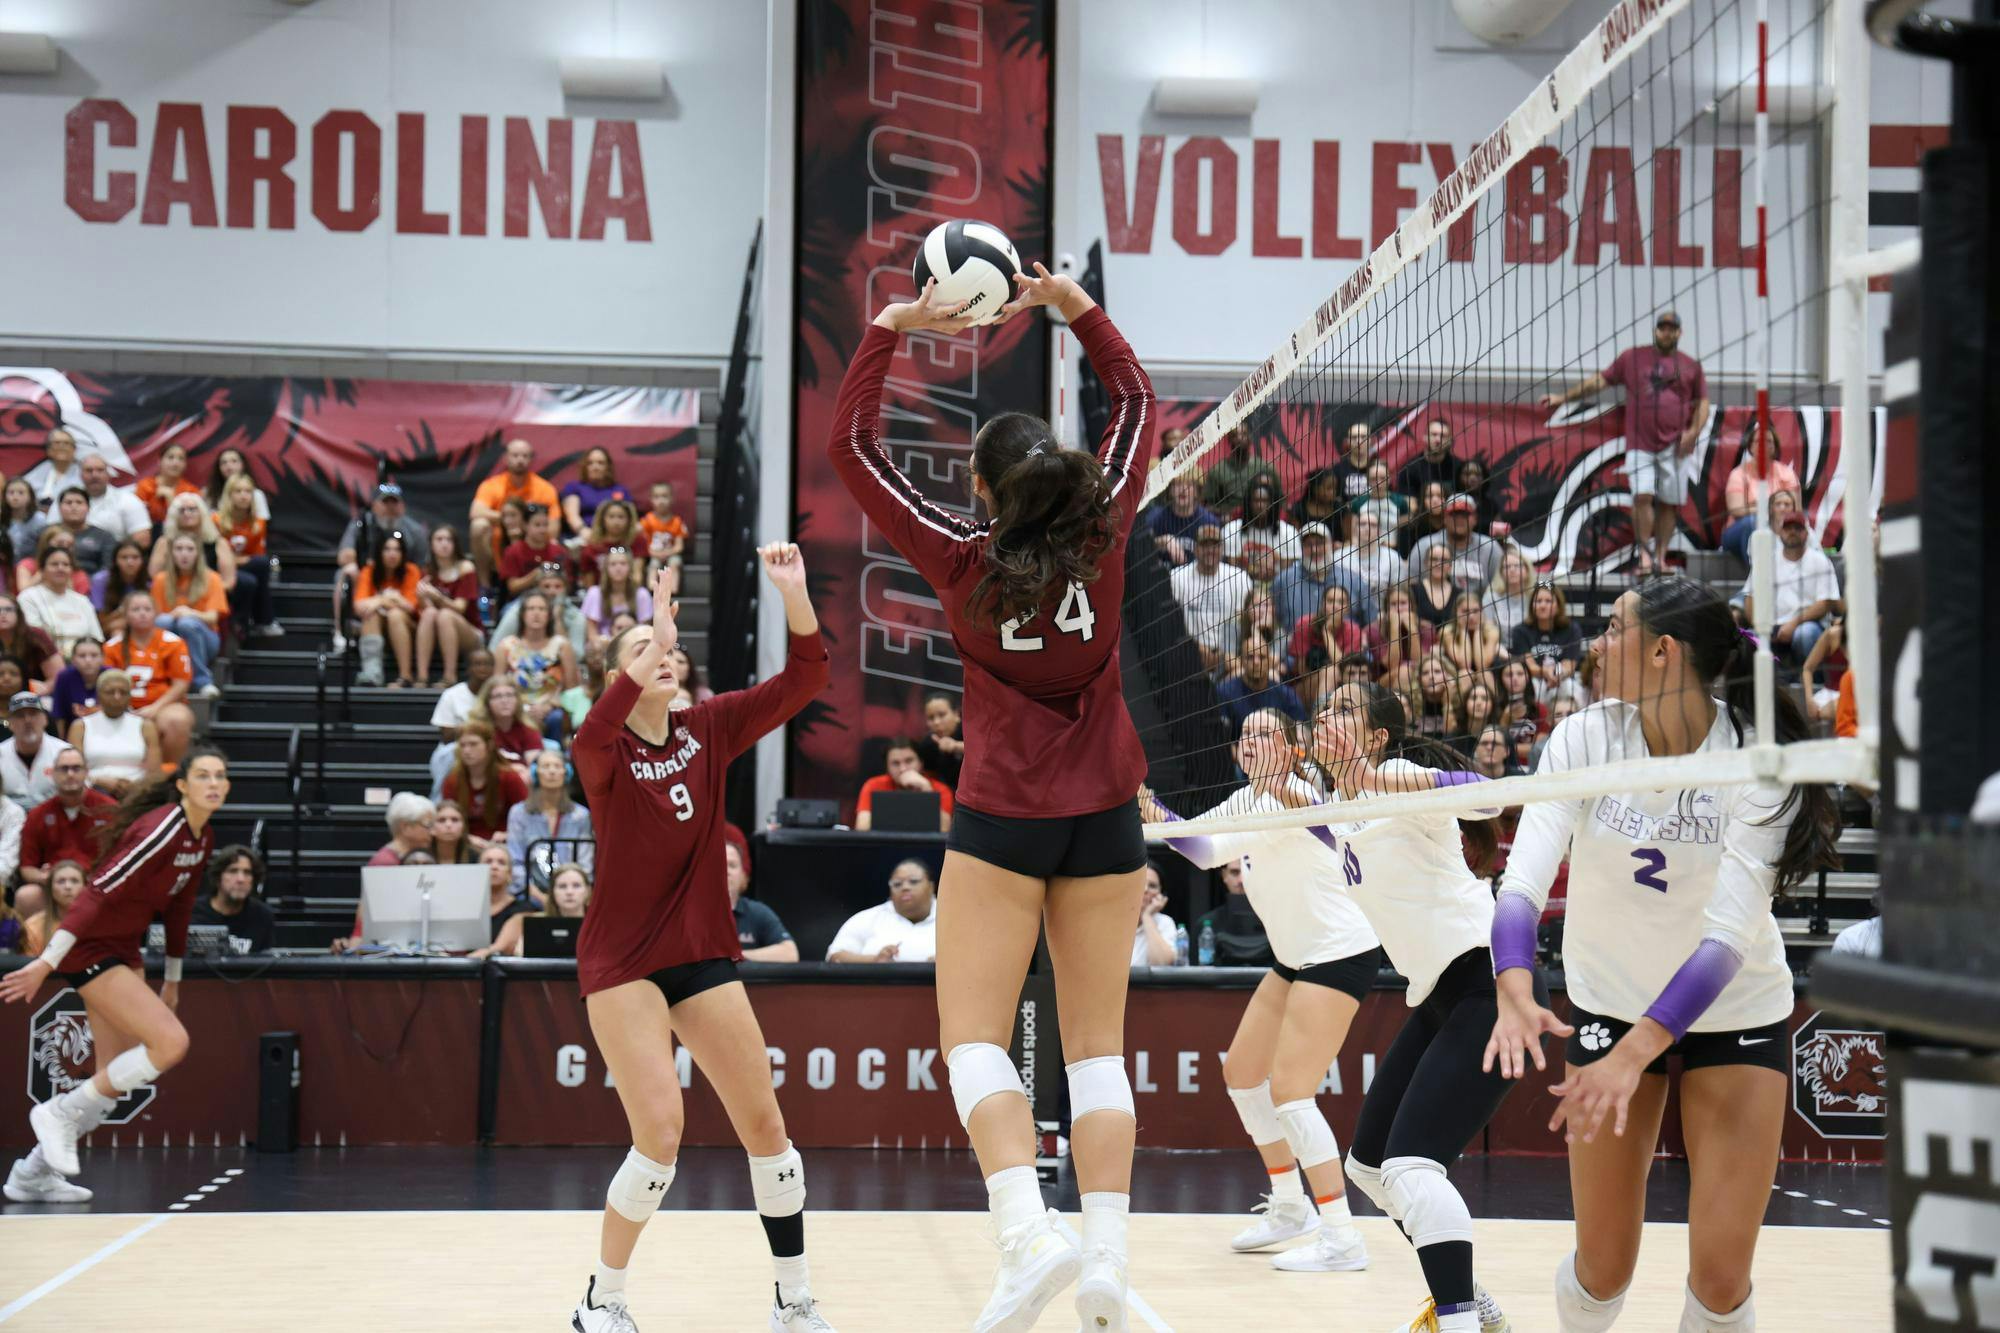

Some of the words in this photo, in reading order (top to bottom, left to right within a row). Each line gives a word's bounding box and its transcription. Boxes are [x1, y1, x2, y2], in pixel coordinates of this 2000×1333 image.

[64, 97, 653, 242] CAROLINA
[1096, 133, 1766, 269] VOLLEYBALL
[1000, 578, 1096, 652] 24
[629, 733, 702, 781] CAROLINA
[668, 782, 695, 822] 9
[1595, 794, 1720, 845] CLEMSON
[1630, 847, 1668, 894] 2
[1020, 999, 1037, 1050] sports
